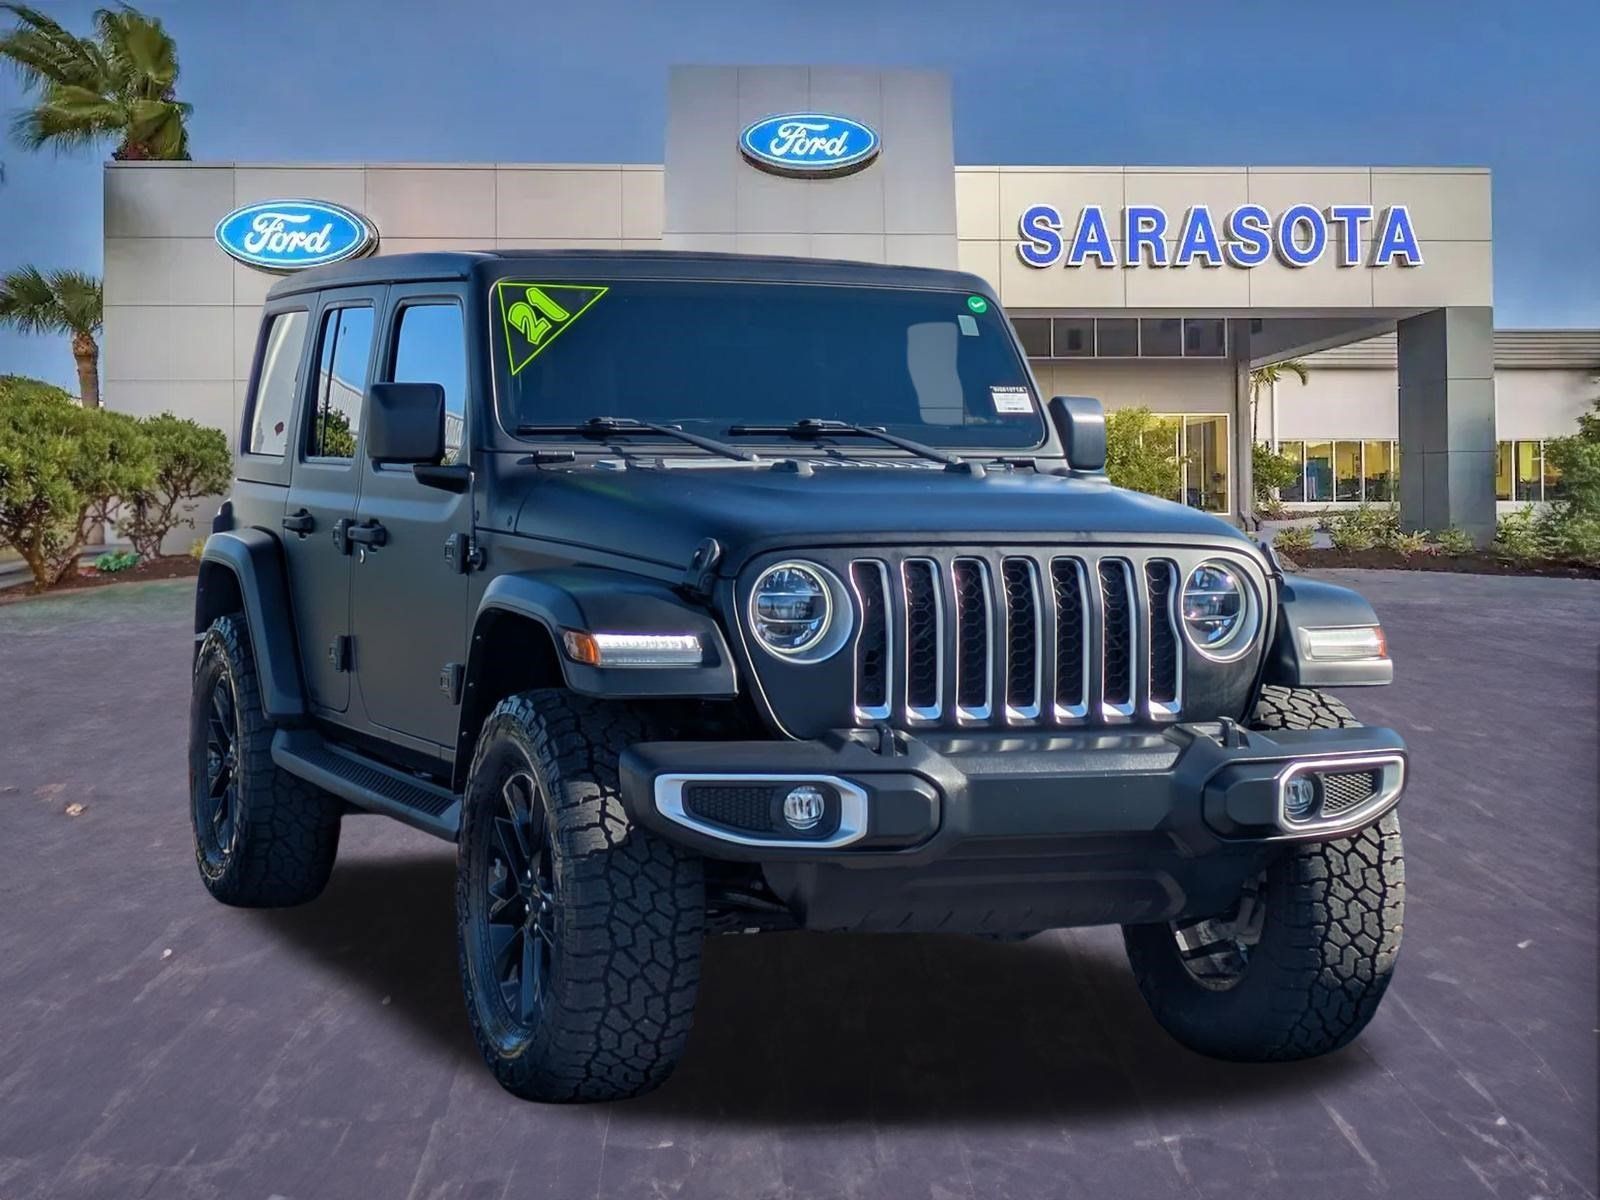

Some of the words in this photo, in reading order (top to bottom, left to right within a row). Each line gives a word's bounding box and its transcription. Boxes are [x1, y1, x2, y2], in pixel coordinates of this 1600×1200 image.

[770, 122, 849, 156] Ford
[244, 212, 333, 253] Ford
[1018, 204, 1424, 267] SARASOTA
[508, 287, 570, 345] 21
